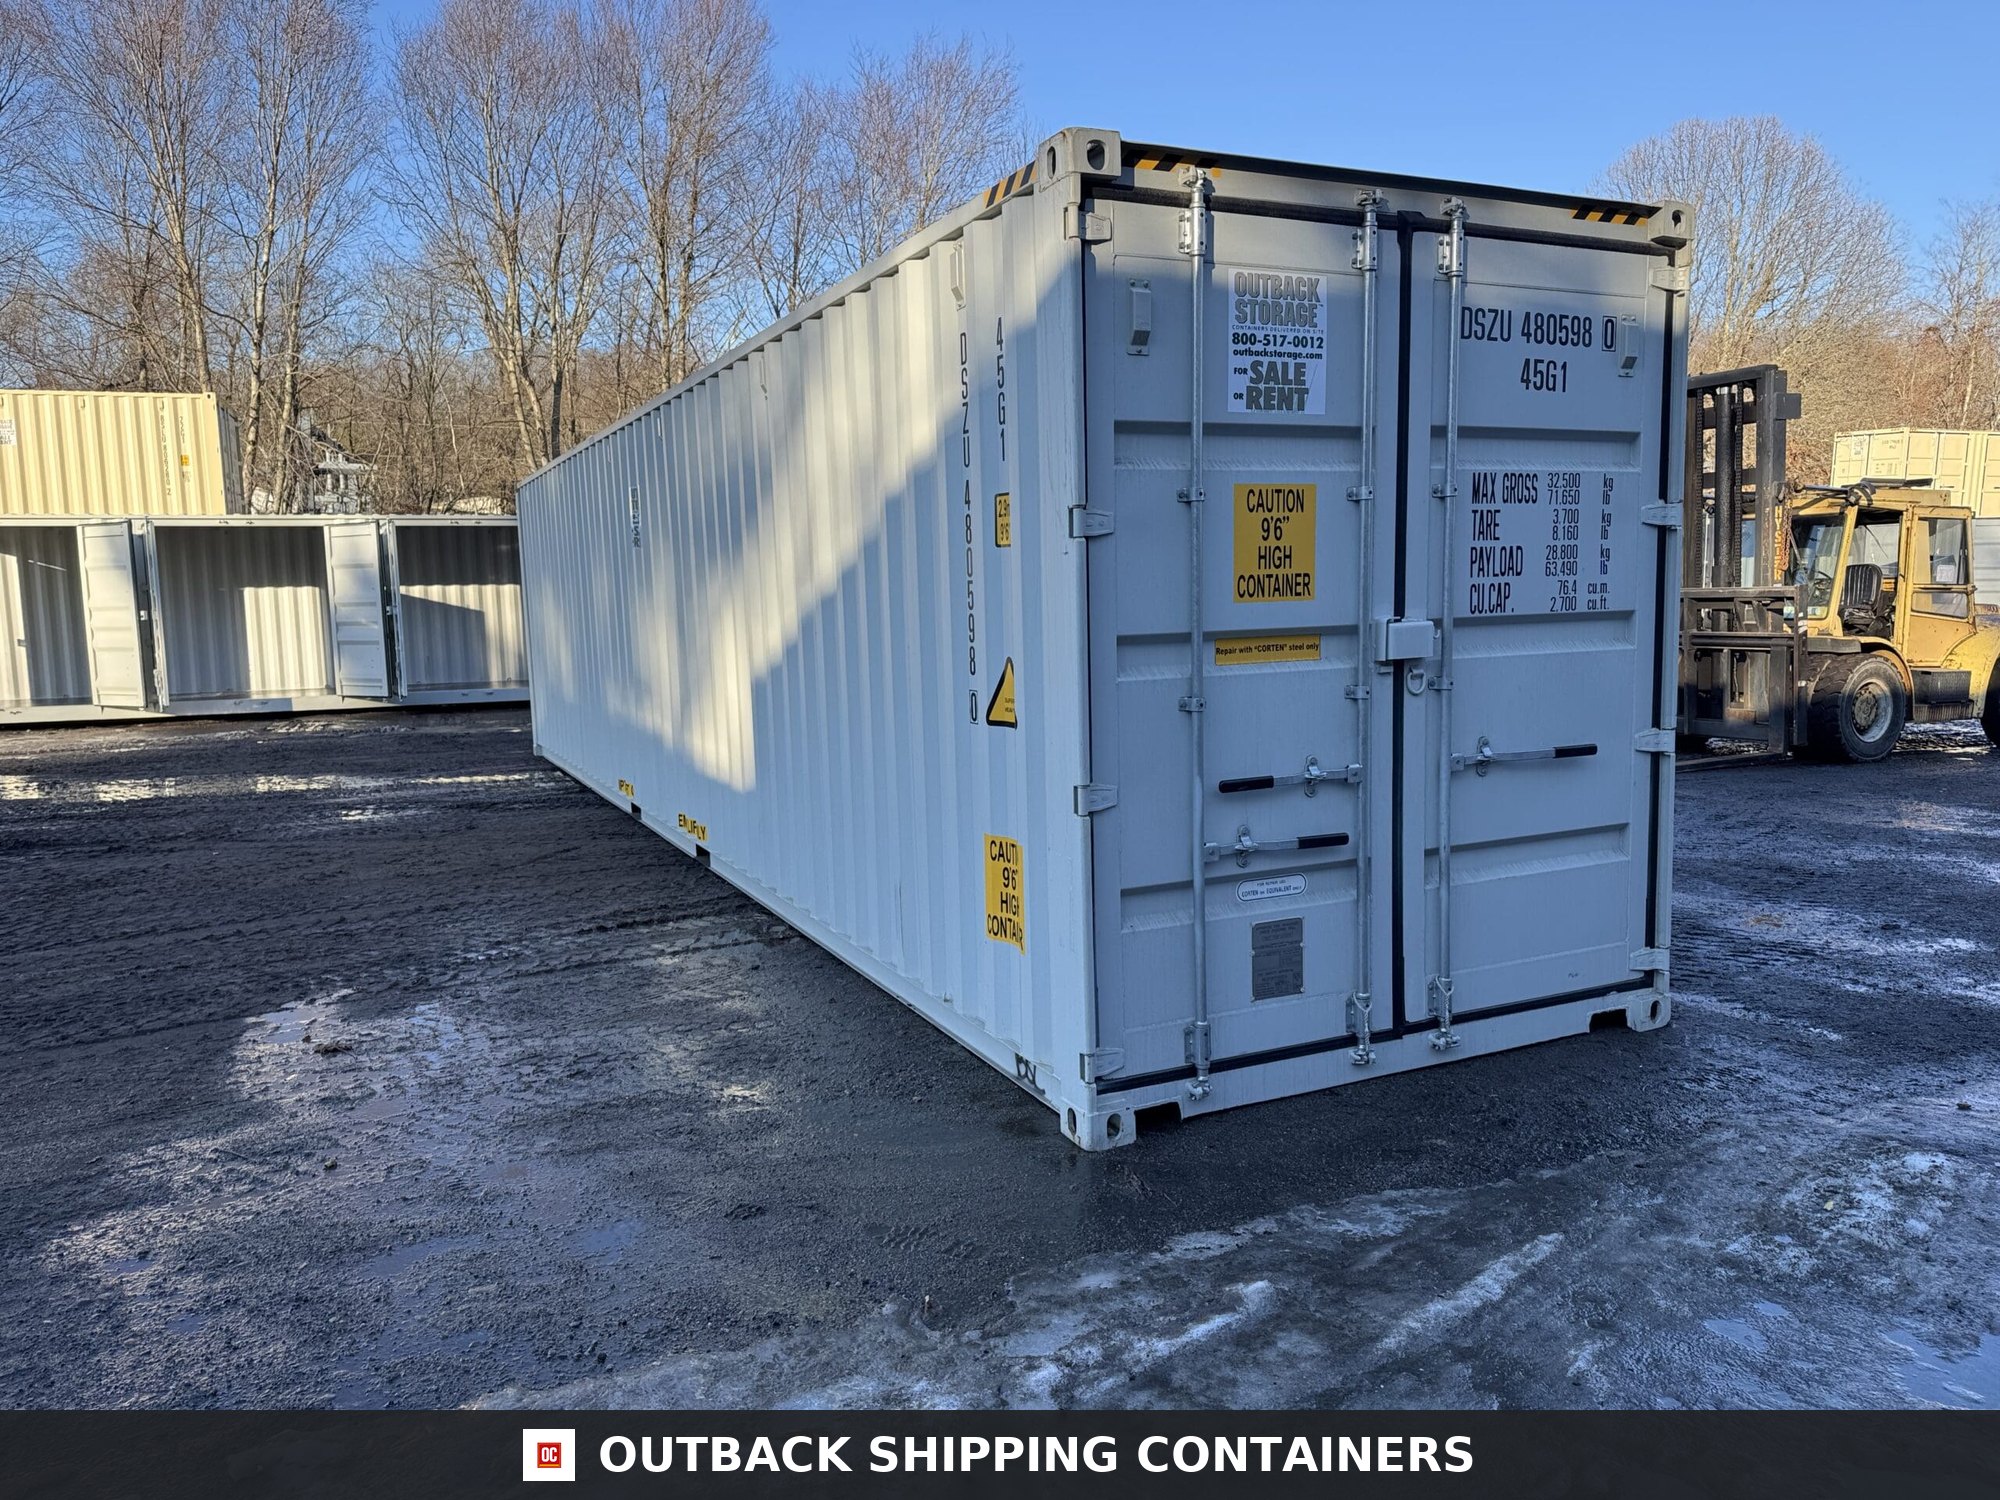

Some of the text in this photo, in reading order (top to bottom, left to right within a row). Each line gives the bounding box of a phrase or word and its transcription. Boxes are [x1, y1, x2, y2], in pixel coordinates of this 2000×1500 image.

[1234, 272, 1320, 303] OUTBACK
[1235, 299, 1318, 328] STORAGE
[1461, 306, 1615, 350] DSZU 480598 0
[1232, 333, 1324, 349] 800-517-0012
[1233, 347, 1323, 360] outbackstorage.com
[1234, 360, 1307, 386] FOR SALE
[1520, 358, 1568, 393] 45G1
[960, 332, 970, 468] DSZU
[996, 317, 1006, 462] 45G1
[1246, 386, 1310, 411] RENT
[1472, 472, 1539, 504] MAX GROSS
[1603, 473, 1614, 491] kg
[1246, 488, 1305, 513] CAUTION
[1602, 489, 1611, 505] lb
[1471, 510, 1501, 541] TARE
[1601, 509, 1612, 527] kg
[1601, 525, 1609, 540] lb
[1258, 545, 1292, 570] HIGH
[1470, 546, 1523, 578] PAYLOAD
[1600, 544, 1611, 562] kg
[964, 480, 976, 675] 480598
[1599, 560, 1608, 575] lb
[1237, 573, 1311, 599] CONTAINER
[1469, 582, 1515, 615] CU.CAP.
[1557, 579, 1611, 596] 76.4 cu.m.
[1587, 595, 1610, 611] cu.ft.
[1216, 642, 1319, 656] Repair with "CORTEN" steel only
[990, 840, 1018, 865] CAUTI
[1266, 885, 1292, 895] EQUIVALENT
